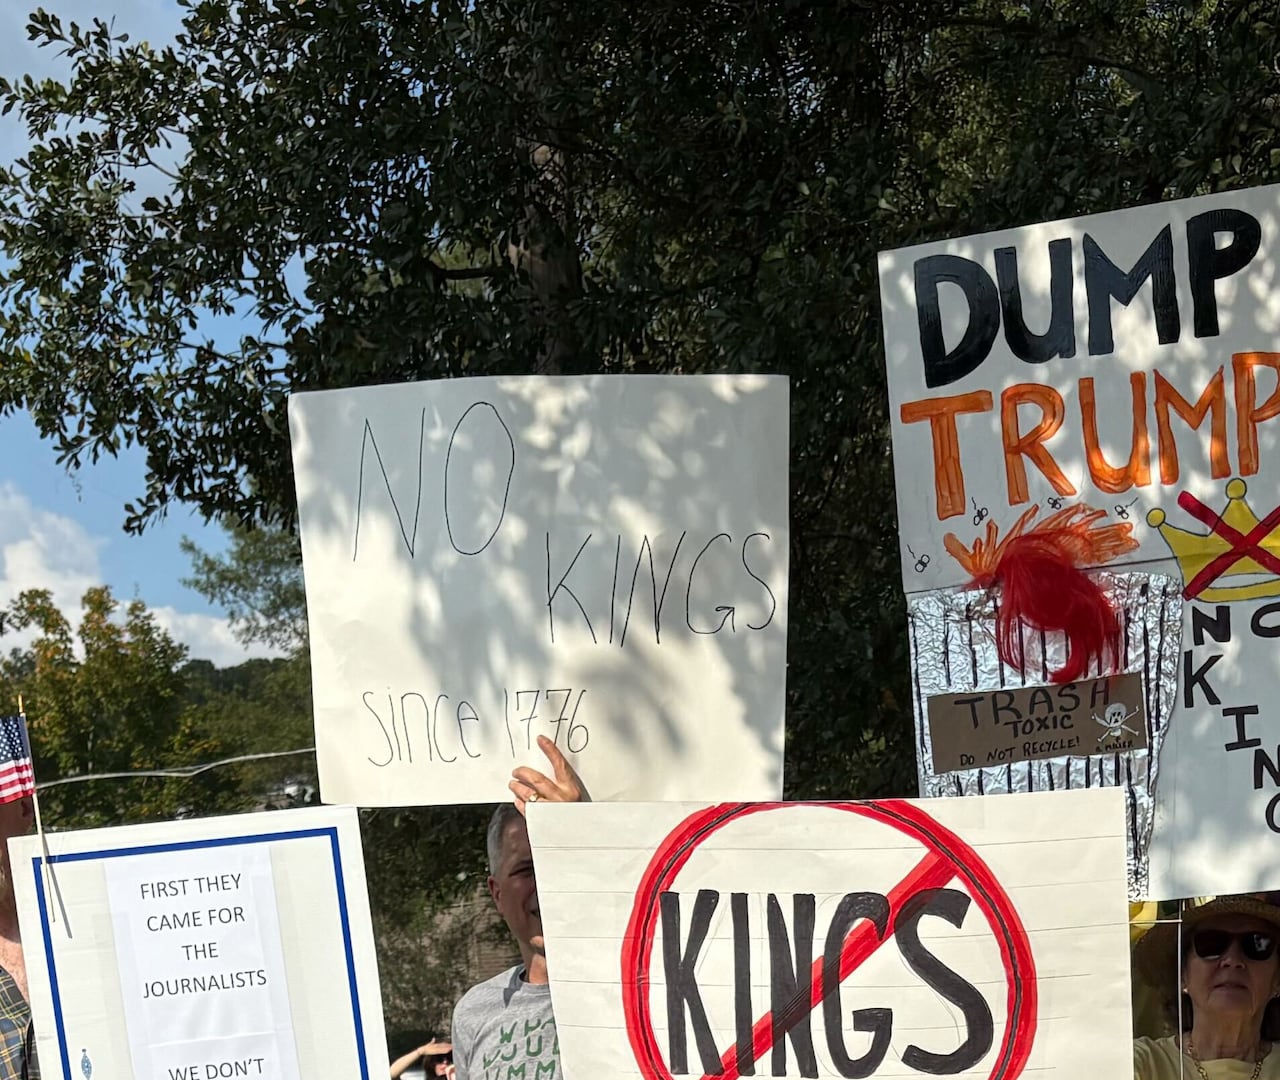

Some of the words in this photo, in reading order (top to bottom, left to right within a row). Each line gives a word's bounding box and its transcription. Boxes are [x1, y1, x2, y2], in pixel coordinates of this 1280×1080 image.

[913, 208, 1261, 389] DUMP
[353, 400, 514, 562] NO
[545, 531, 776, 648] KINGS
[503, 688, 590, 759] 1776
[954, 681, 1110, 729] TRASH
[1003, 715, 1074, 738] TOXIC
[960, 754, 975, 766] DO
[987, 746, 1016, 762] NOT
[1023, 736, 1081, 757] RECYCLE!
[140, 878, 188, 900] FIRST
[193, 873, 242, 894] THEY
[146, 909, 202, 933] CAME
[207, 905, 245, 926] FOR
[181, 941, 219, 961] THE
[143, 969, 268, 999] JOURNALISTS
[660, 888, 994, 1080] KINGS
